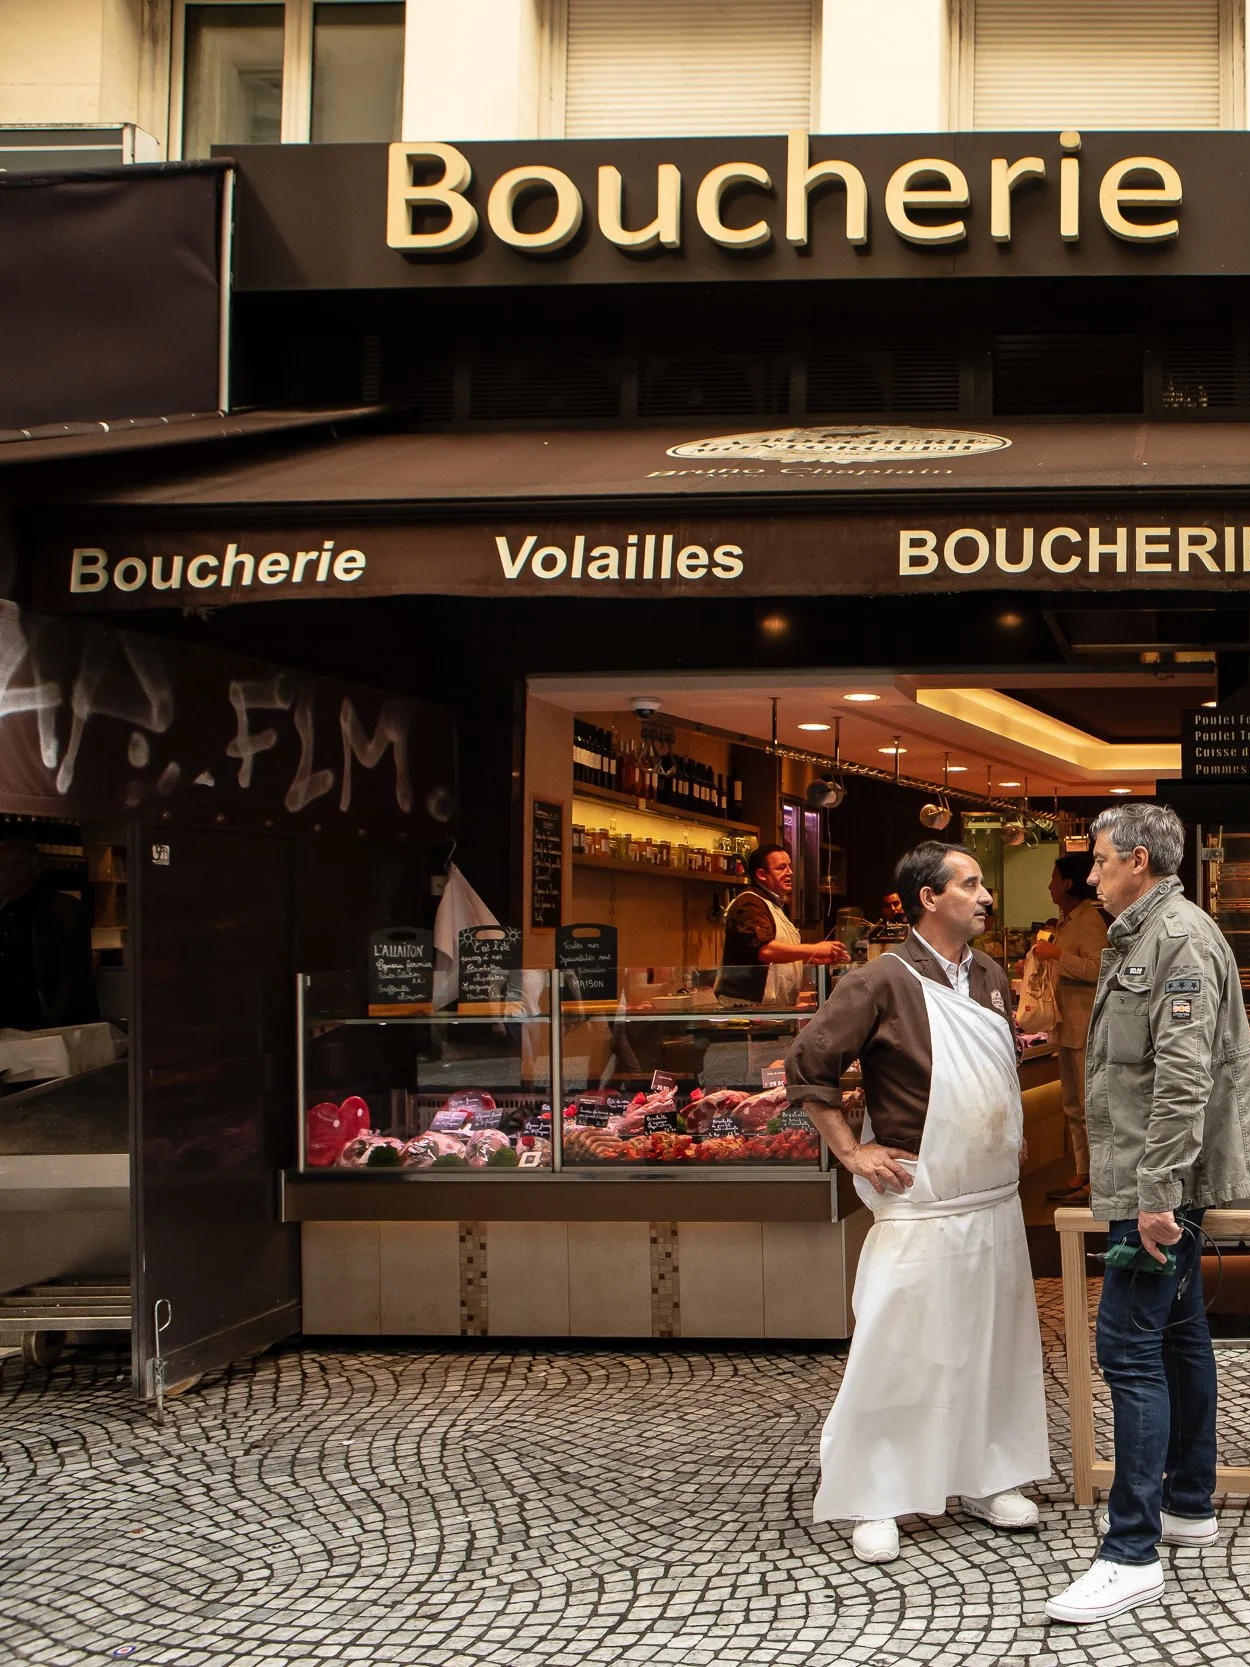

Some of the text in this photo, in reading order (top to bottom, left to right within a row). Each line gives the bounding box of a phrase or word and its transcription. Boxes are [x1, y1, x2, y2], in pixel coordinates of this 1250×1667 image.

[387, 130, 1183, 252] Boucherie
[643, 467, 766, 478] Bruno
[780, 466, 953, 476] Chaplain
[494, 533, 745, 581] Volailles
[70, 540, 366, 593] Boucherie
[1195, 714, 1236, 726] Poulet
[1195, 730, 1236, 742] Poulet
[1195, 746, 1237, 758] Cuisse
[1195, 763, 1247, 776] Pommes
[563, 940, 583, 951] Toutes
[572, 979, 605, 990] MAISON
